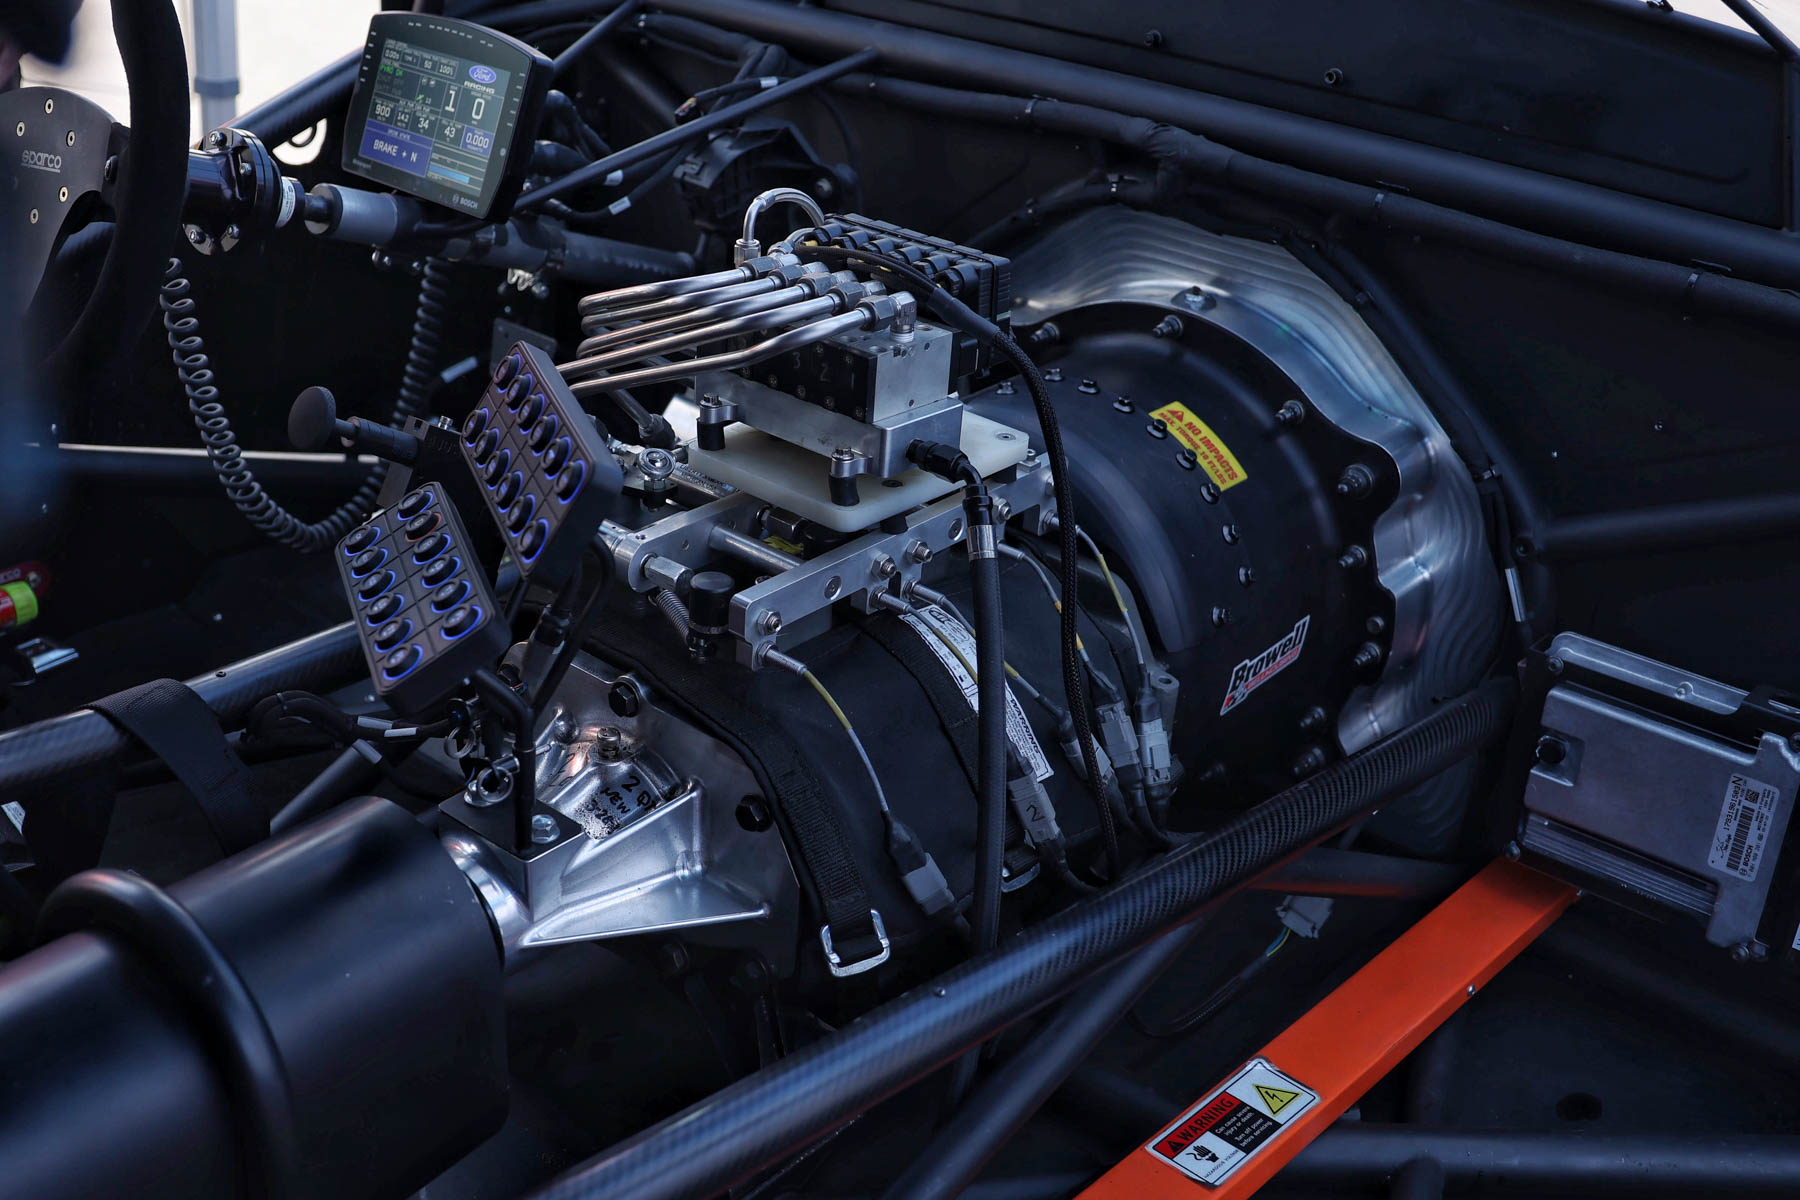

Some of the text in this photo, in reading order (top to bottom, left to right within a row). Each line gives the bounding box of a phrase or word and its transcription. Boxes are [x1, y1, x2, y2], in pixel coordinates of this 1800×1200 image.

[472, 66, 492, 82] Ford
[464, 80, 496, 95] RACING
[374, 103, 391, 119] 900
[444, 90, 456, 113] 1
[471, 97, 486, 120] 0
[417, 116, 430, 130] 34
[444, 126, 456, 138] 43
[373, 138, 399, 157] BRAKE
[410, 151, 418, 163] N
[465, 132, 490, 149] 0.000
[21, 150, 62, 169] sparco
[459, 197, 479, 210] BOSCH
[1176, 426, 1201, 450] TORQUE
[1184, 421, 1238, 481] NO IMPACTS
[1228, 618, 1309, 694] Browell
[1010, 698, 1041, 754] WARNING
[1026, 804, 1044, 822] 2
[1743, 844, 1753, 866] BOSCH
[1179, 1097, 1234, 1141] WARNING
[1215, 1106, 1250, 1134] Can cause severe
[1224, 1125, 1238, 1136] injury
[1234, 1133, 1245, 1141] Turn
[1251, 1118, 1263, 1129] power
[1240, 1135, 1254, 1147] before
